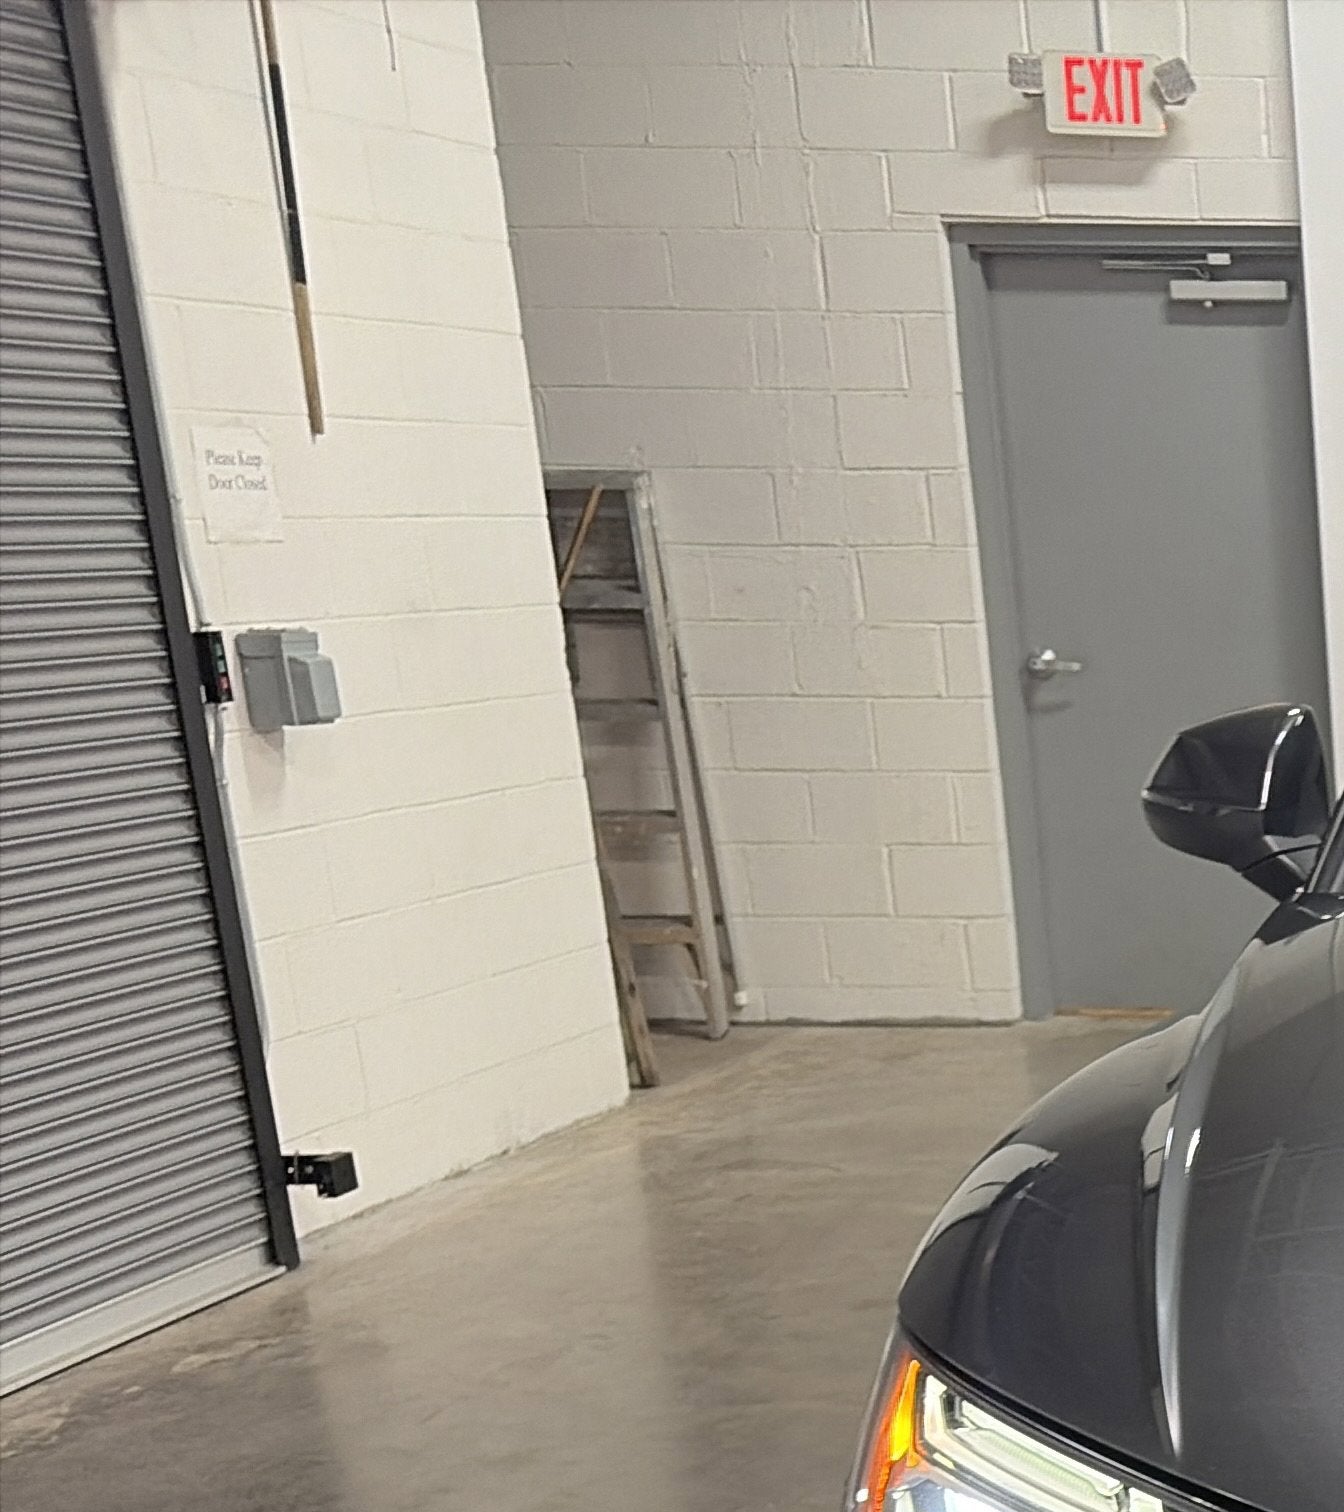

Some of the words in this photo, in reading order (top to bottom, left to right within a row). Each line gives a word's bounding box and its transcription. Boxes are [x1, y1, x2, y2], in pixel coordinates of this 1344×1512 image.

[1063, 55, 1144, 124] EXIT
[205, 449, 236, 466] Please
[237, 450, 262, 471] Keep
[208, 473, 233, 490] Door
[235, 474, 267, 490] Closed
